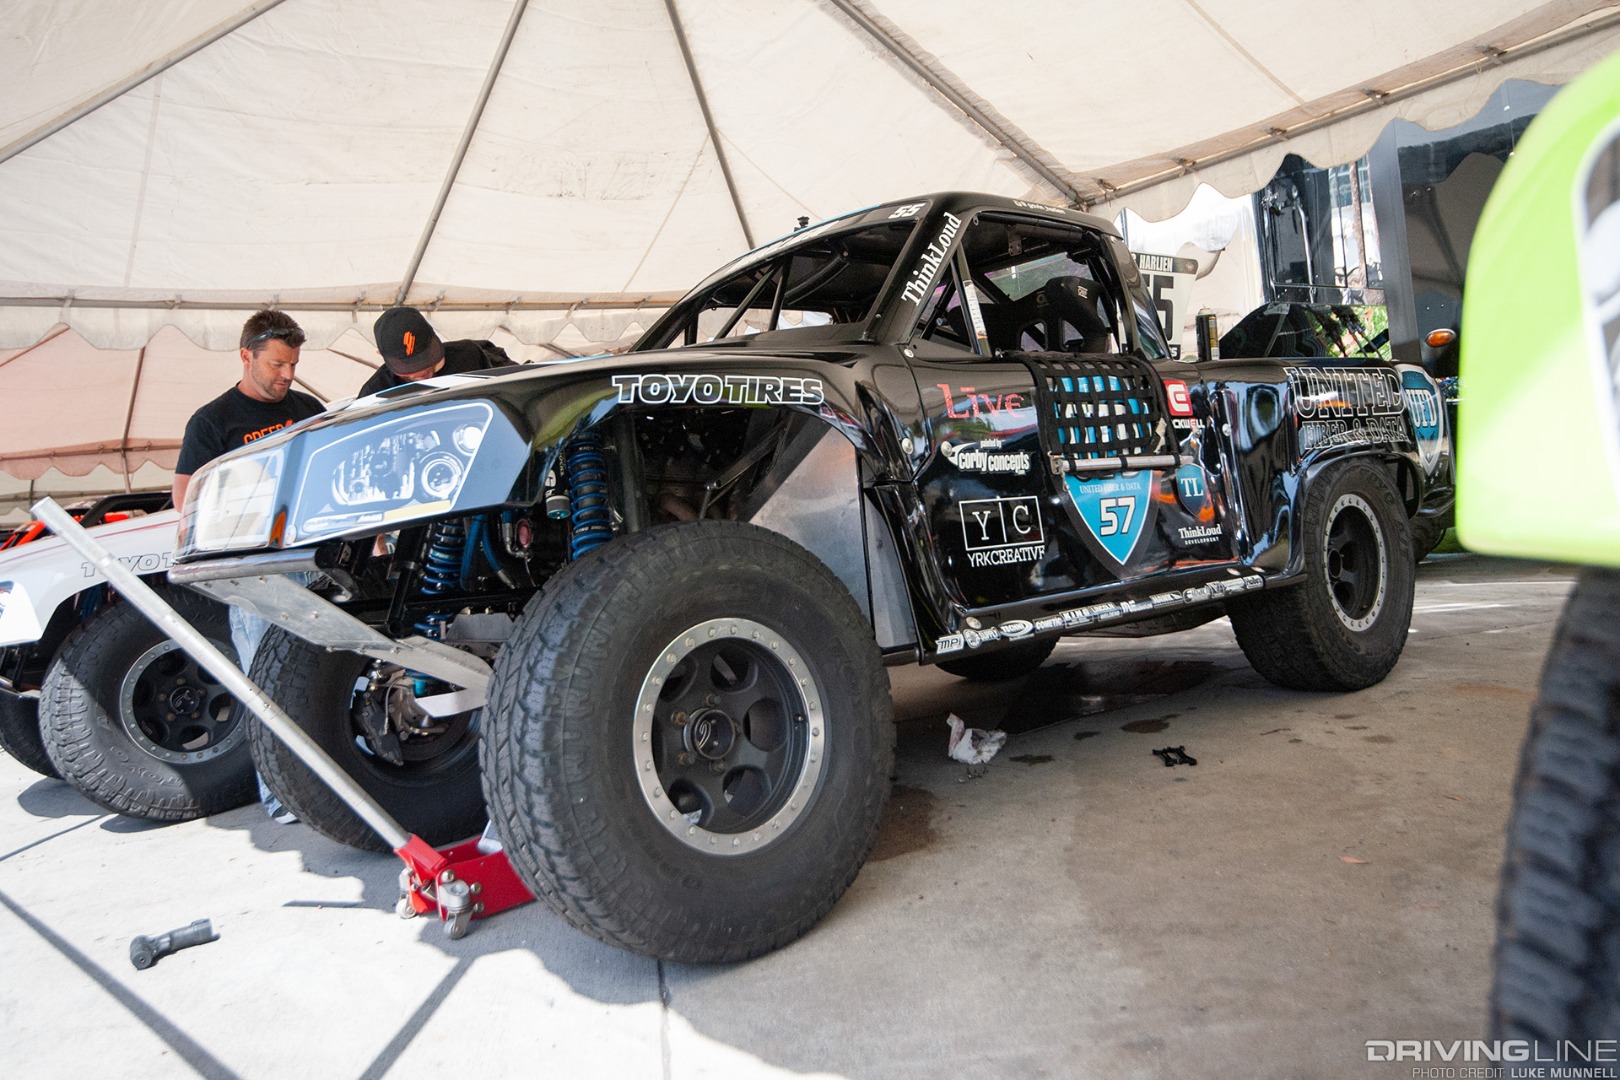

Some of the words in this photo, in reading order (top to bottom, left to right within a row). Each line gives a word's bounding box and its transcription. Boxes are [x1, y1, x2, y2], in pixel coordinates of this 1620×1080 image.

[888, 203, 926, 219] 55
[901, 211, 962, 307] ThinkLoud
[1139, 254, 1172, 272] HARLIEN
[1283, 366, 1407, 419] UNITED
[1405, 389, 1438, 428] UFD
[1302, 420, 1348, 450] FIBER
[1352, 418, 1369, 446] &
[1366, 416, 1411, 444] DATA
[958, 449, 988, 472] corby
[987, 451, 1030, 473] concepts
[1079, 484, 1102, 495] UNITED
[1125, 482, 1142, 491] DATA
[1180, 477, 1204, 498] TL
[971, 510, 992, 541] Y
[1012, 504, 1032, 535] C
[1100, 495, 1136, 538] 57
[1178, 524, 1223, 540] ThinkLoud
[1184, 536, 1220, 546] DEVELOPMENT
[937, 637, 962, 650] MPI
